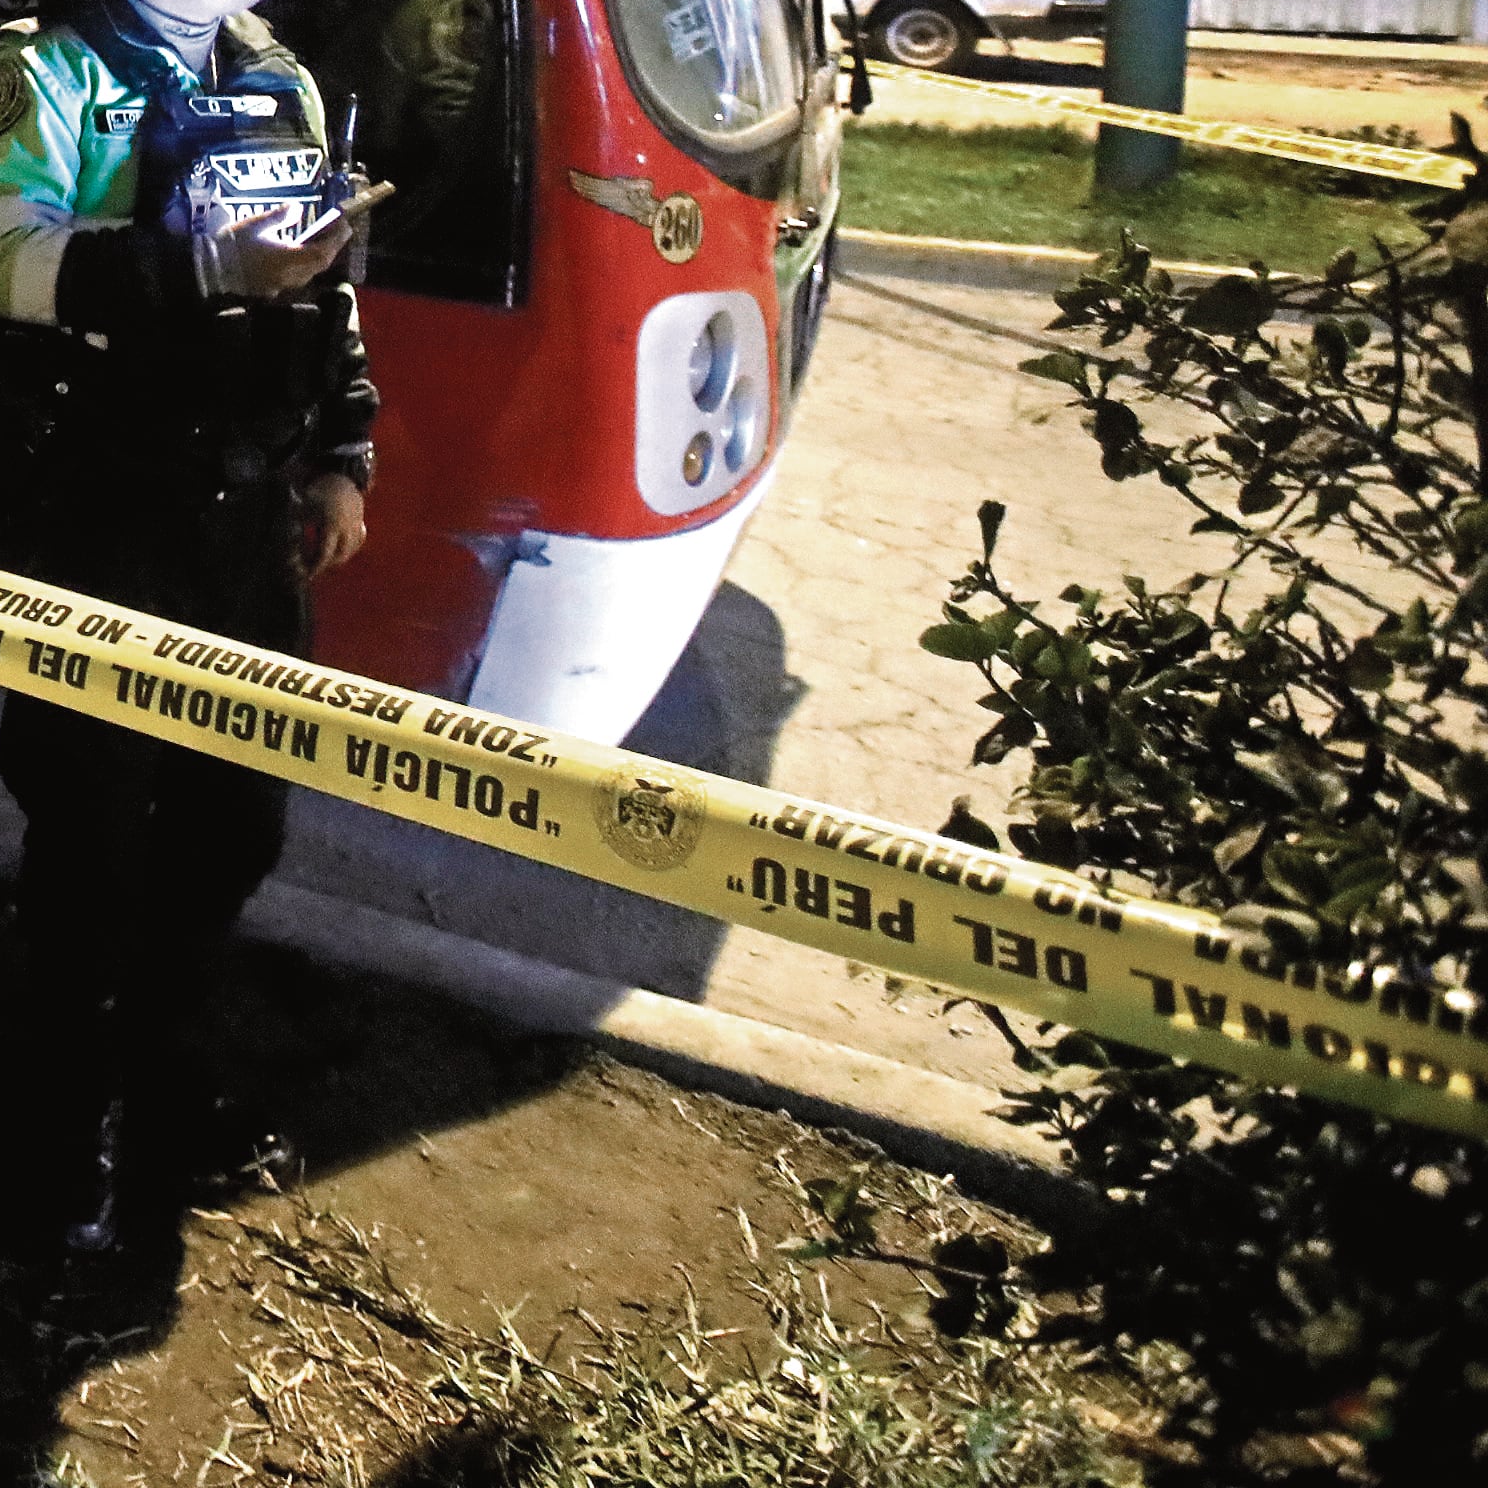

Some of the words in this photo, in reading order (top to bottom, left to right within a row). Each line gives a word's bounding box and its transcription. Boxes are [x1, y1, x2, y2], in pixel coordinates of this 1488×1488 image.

[23, 636, 92, 690] DEL
[75, 613, 134, 645] NO
[111, 662, 321, 763] NACIONAL
[152, 633, 414, 725] RESTRINGIDA
[952, 913, 1089, 993] DEL
